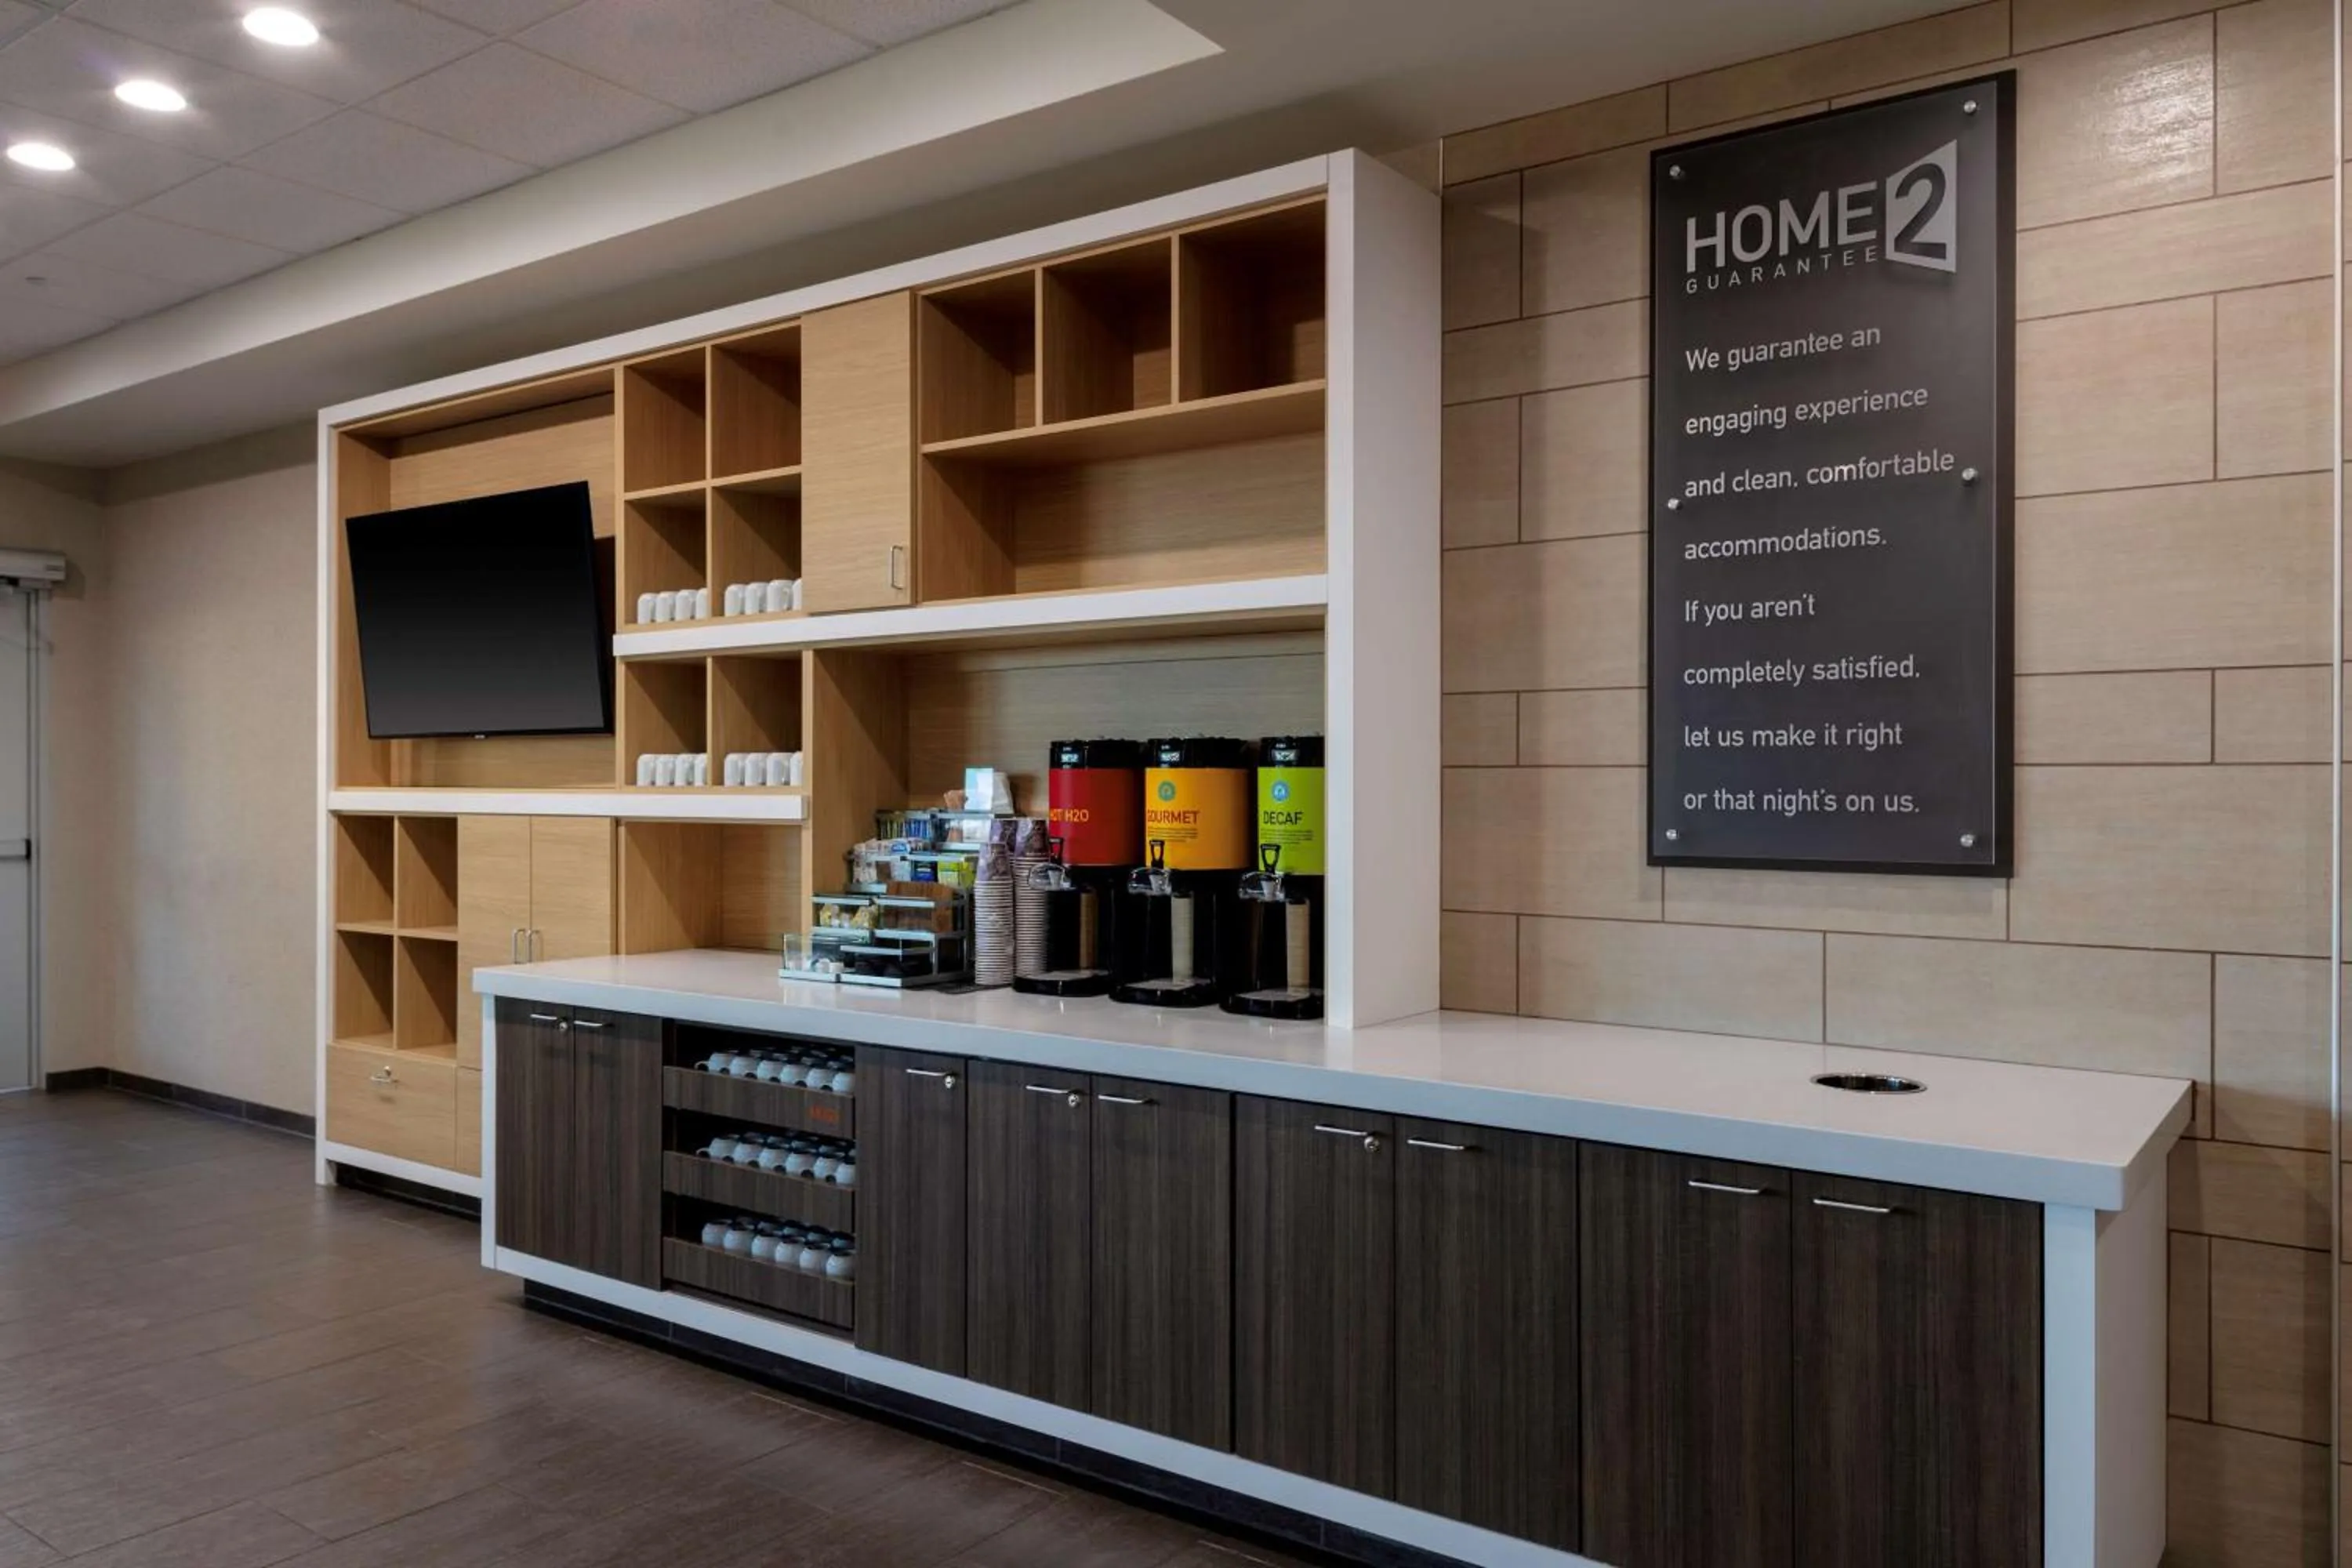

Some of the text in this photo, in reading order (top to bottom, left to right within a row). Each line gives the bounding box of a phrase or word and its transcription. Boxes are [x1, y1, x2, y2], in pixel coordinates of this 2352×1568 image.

[1686, 245, 1880, 295] GUARANTEE
[1686, 327, 1882, 372] We guarantee an
[1685, 387, 1929, 436] engaging experience
[1685, 473, 1726, 498] and
[1806, 448, 1955, 485] comfortable
[1684, 525, 1888, 561] accommodations.
[1684, 593, 1817, 626] If you aren't
[1683, 659, 1806, 689] completely
[1684, 722, 1904, 752] let us make it right
[1065, 808, 1090, 822] H2O
[1147, 809, 1200, 825] GOURMET
[1683, 789, 1920, 816] or that night's on us.
[1263, 811, 1304, 826] DECAF
